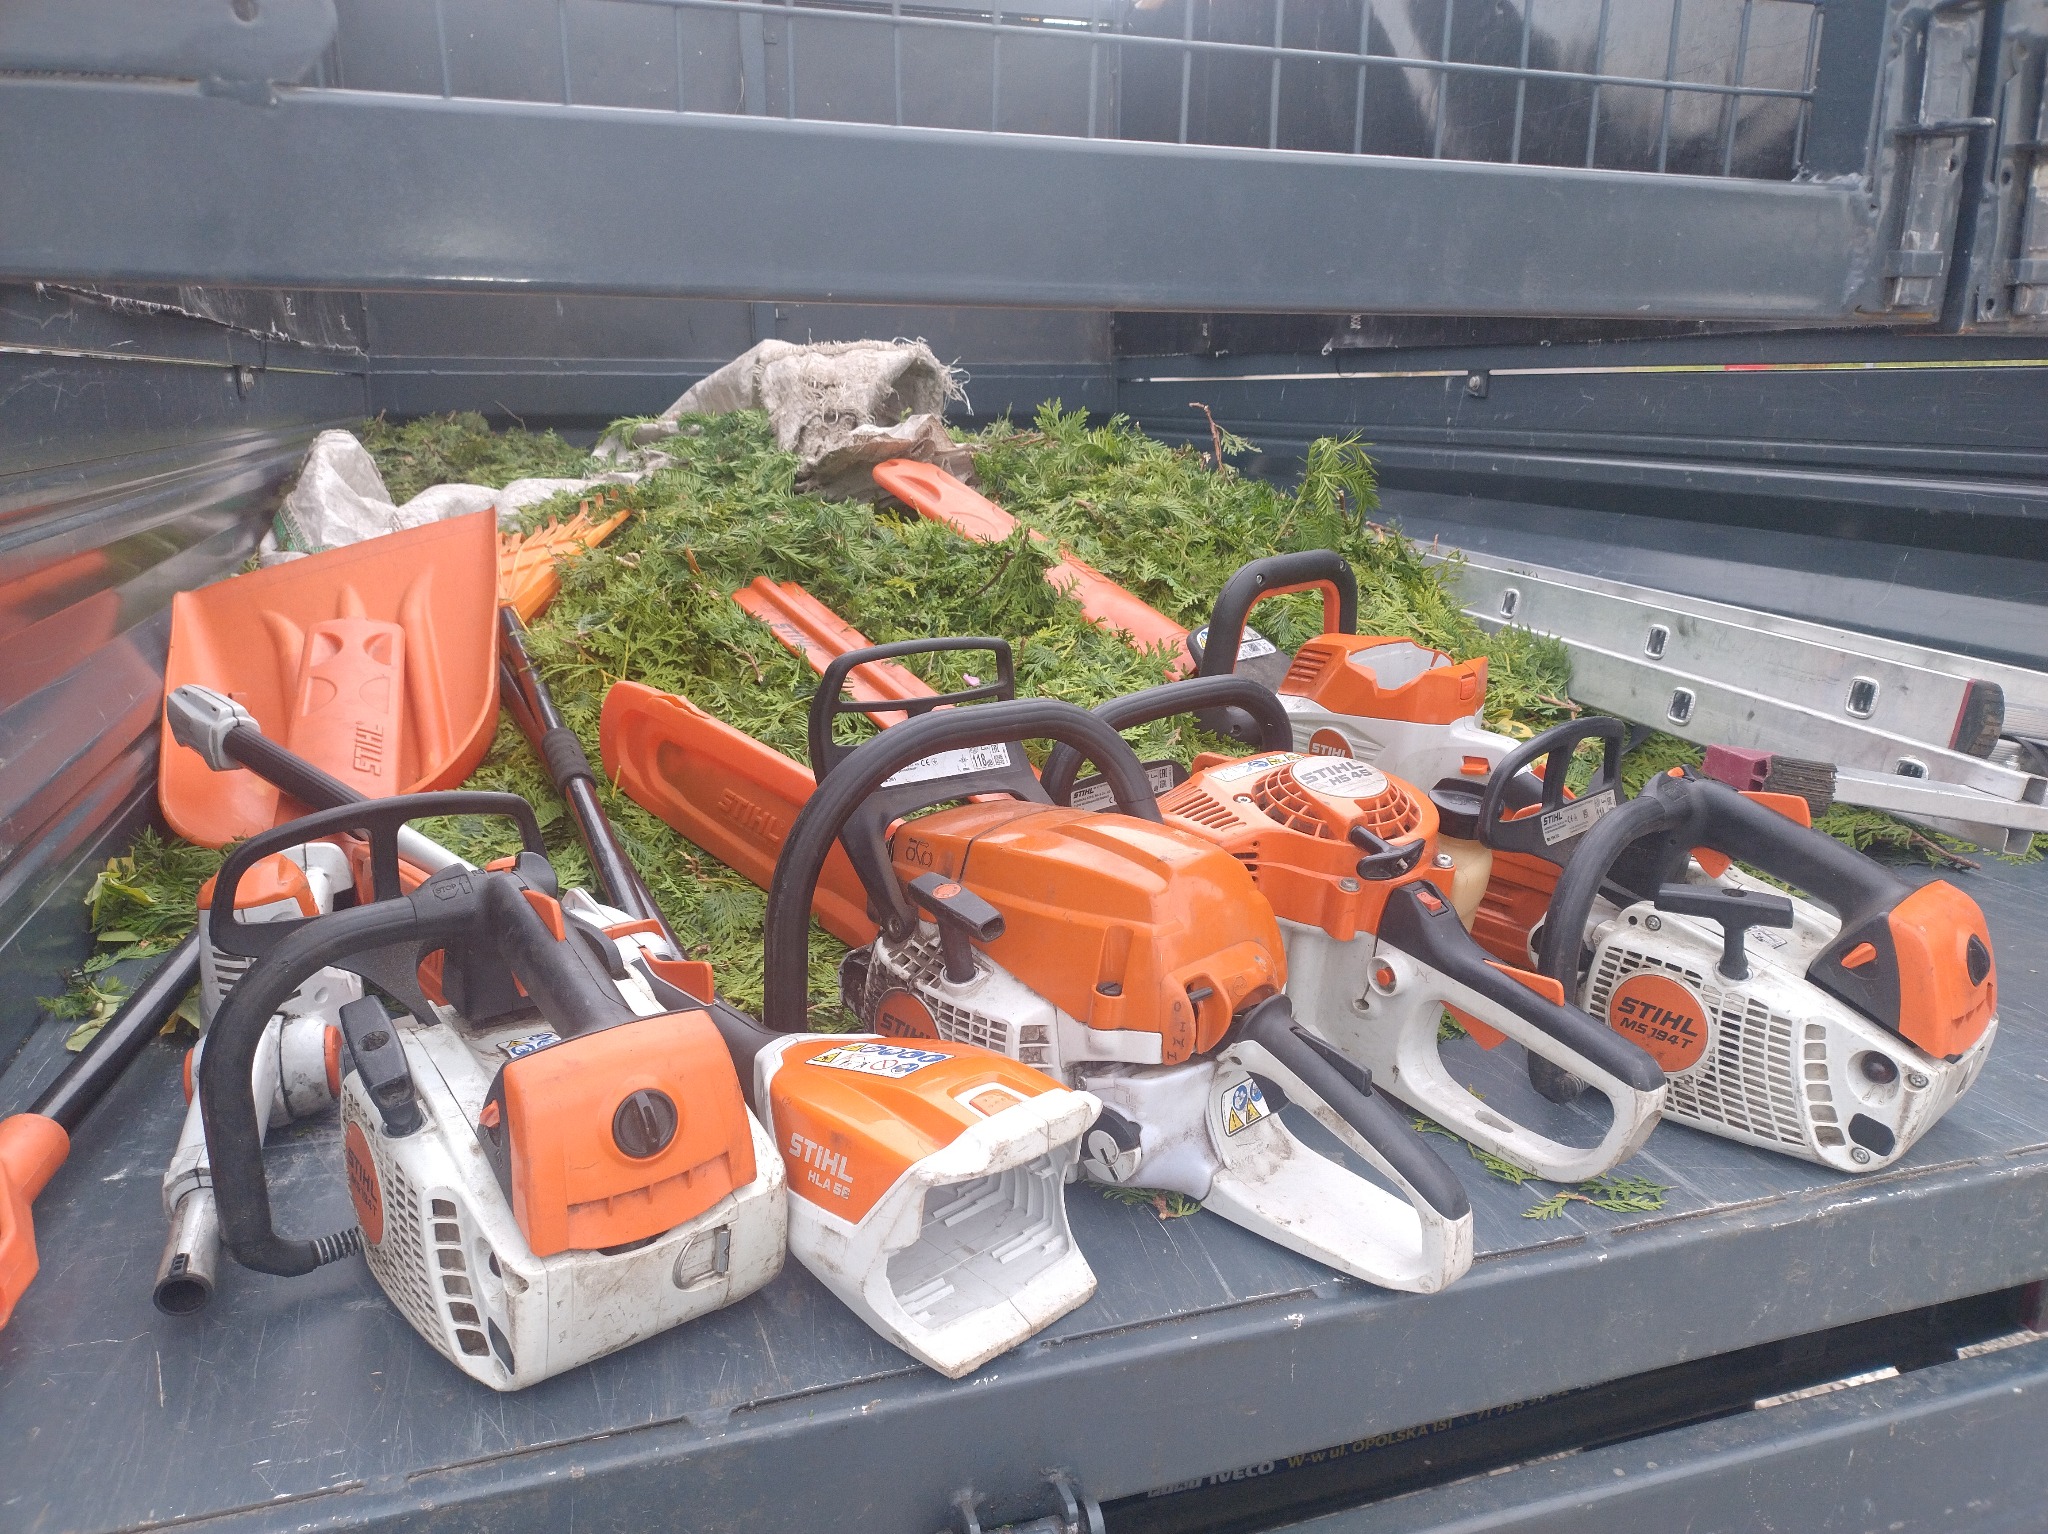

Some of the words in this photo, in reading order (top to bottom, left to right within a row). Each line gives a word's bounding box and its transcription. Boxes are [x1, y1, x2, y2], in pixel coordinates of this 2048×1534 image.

[353, 725, 384, 777] STIHL
[1299, 761, 1364, 785] STIHL
[1328, 773, 1352, 786] HS
[1073, 787, 1095, 799] STIHL
[718, 787, 781, 842] STIHL
[1543, 811, 1563, 827] STIHL
[435, 883, 457, 895] STOP
[880, 1012, 931, 1039] STIH
[1617, 996, 1698, 1038] STIHL
[1620, 1017, 1649, 1035] MS
[1648, 1027, 1680, 1046] 194
[1682, 1037, 1694, 1049] T
[788, 1132, 854, 1184] STIHL
[348, 1147, 377, 1203] STIHL
[807, 1169, 831, 1192] HLA
[1209, 1460, 1275, 1486] IVECO
[1352, 1424, 1429, 1454] OPOLSKA
